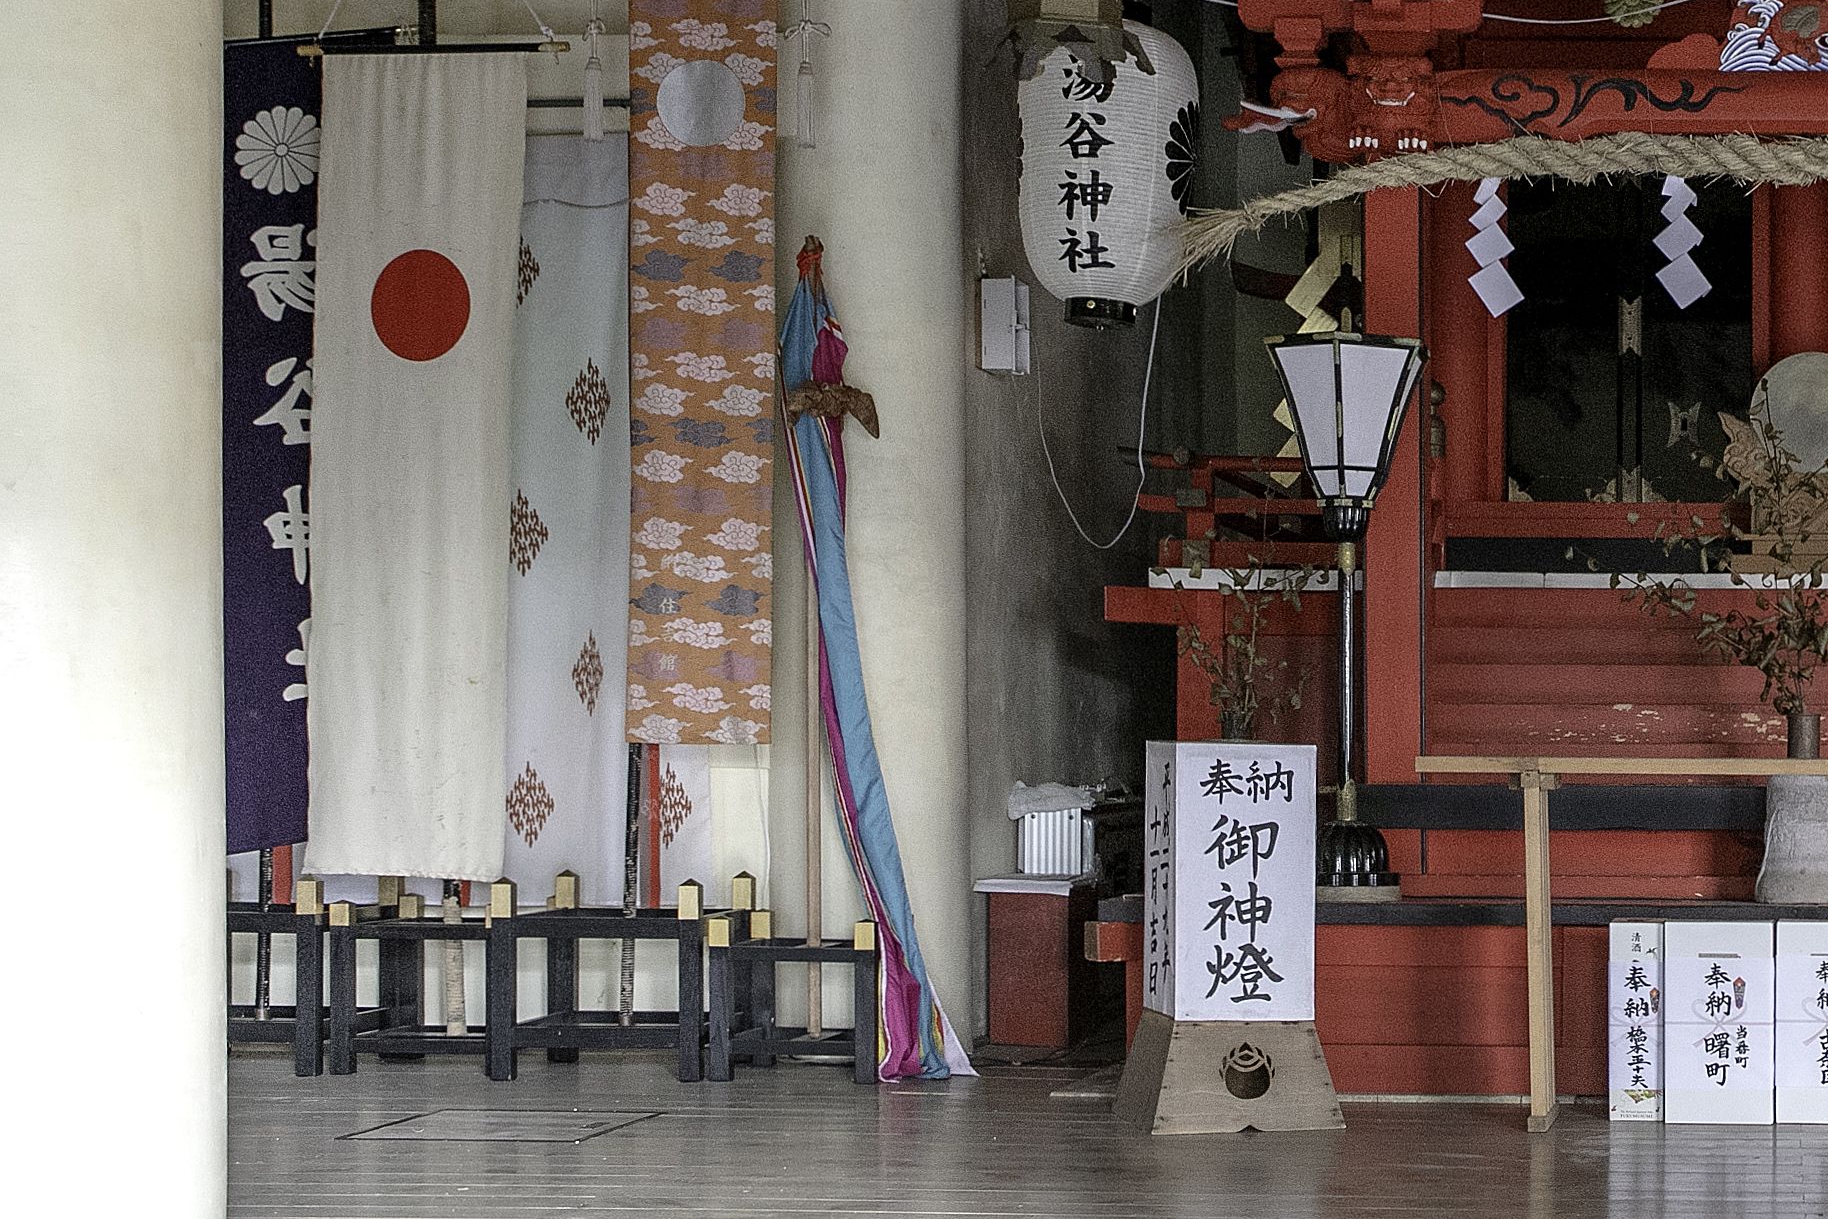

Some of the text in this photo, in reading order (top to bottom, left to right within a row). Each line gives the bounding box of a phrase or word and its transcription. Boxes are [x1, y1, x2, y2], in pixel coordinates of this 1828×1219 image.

[1058, 54, 1115, 274] 湯谷神社
[1199, 758, 1295, 805] 奉納
[1203, 814, 1285, 1004] 御神燈
[1631, 932, 1642, 953] 清酒
[1624, 966, 1652, 1019] 奉納
[1703, 963, 1732, 1087] 奉納 曙町
